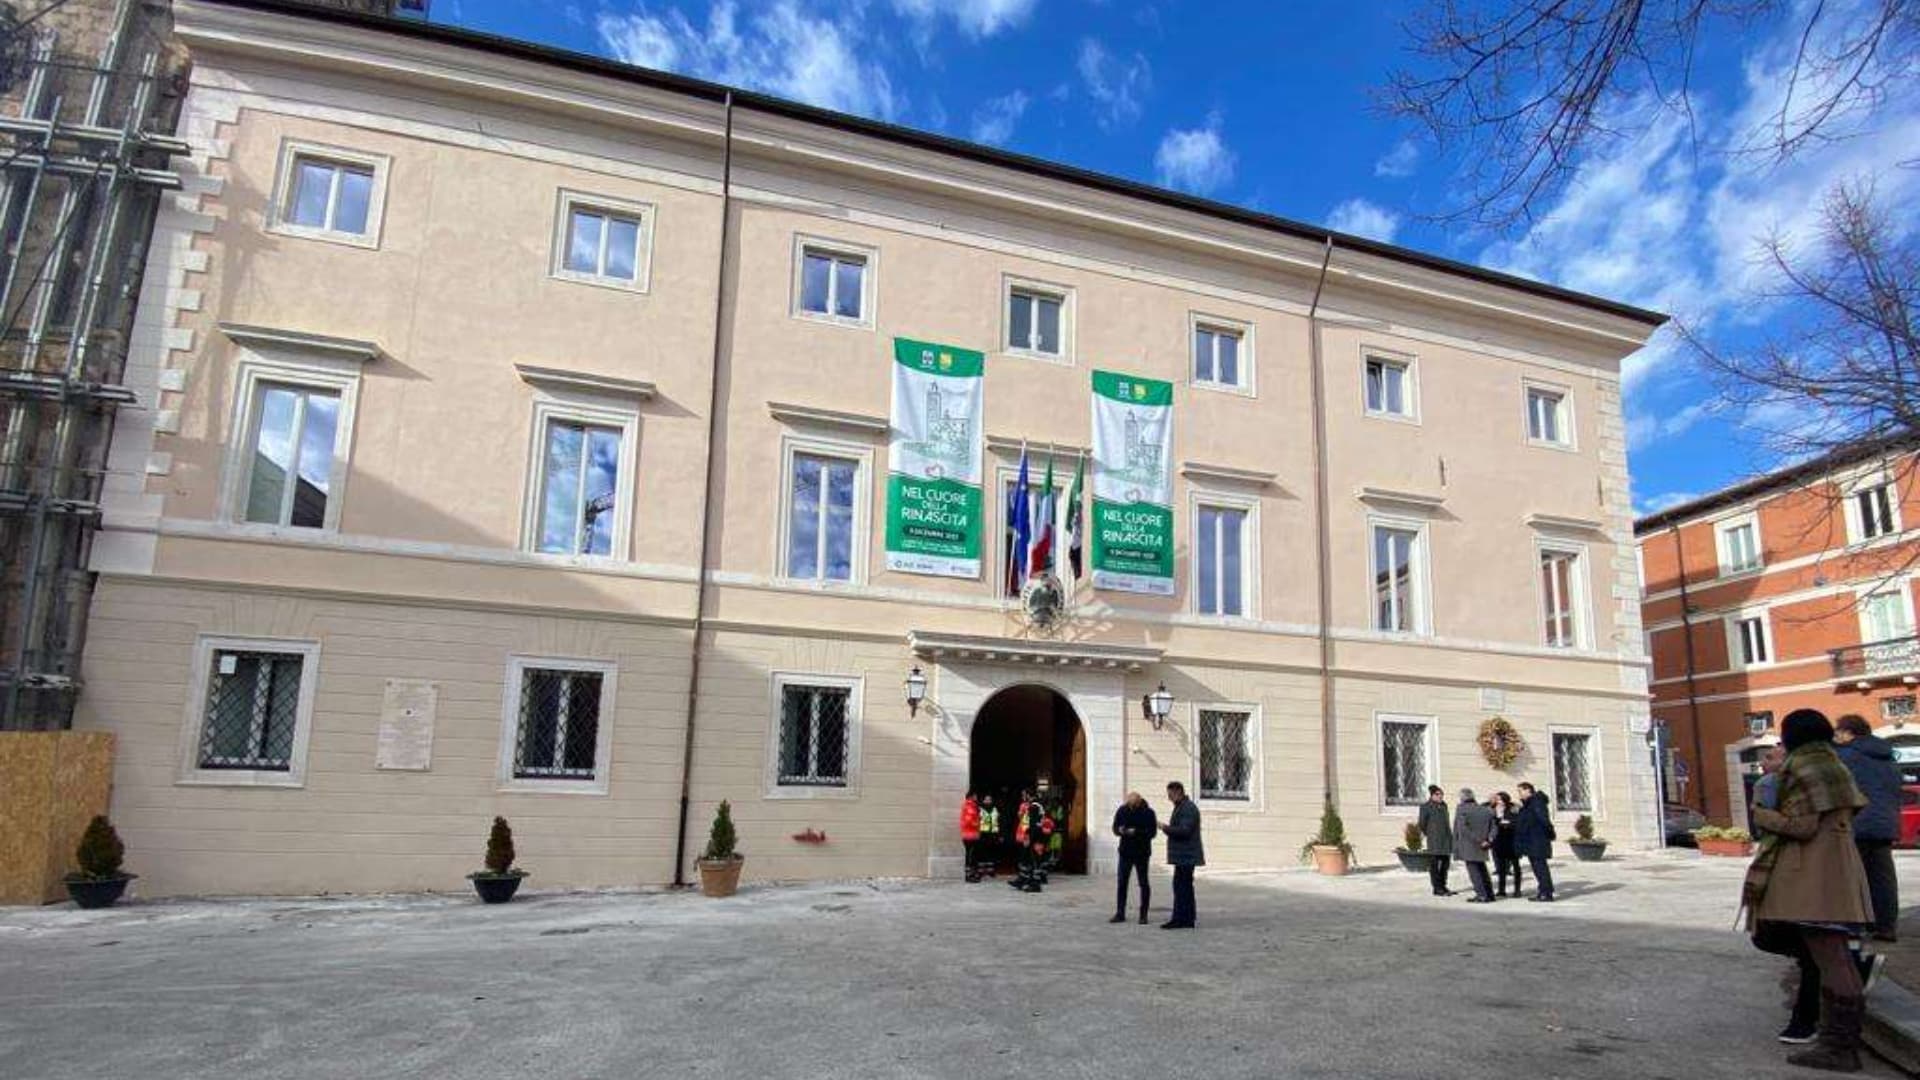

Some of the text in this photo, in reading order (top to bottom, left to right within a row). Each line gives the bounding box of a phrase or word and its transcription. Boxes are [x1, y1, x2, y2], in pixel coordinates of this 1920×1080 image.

[902, 485, 967, 506] NEL CUORE
[921, 501, 948, 511] DELLA
[901, 506, 967, 527] RINASCITA
[1103, 509, 1163, 528] NEL CUORE
[1121, 522, 1145, 533] DELLA
[1102, 529, 1163, 547] RINASCITA
